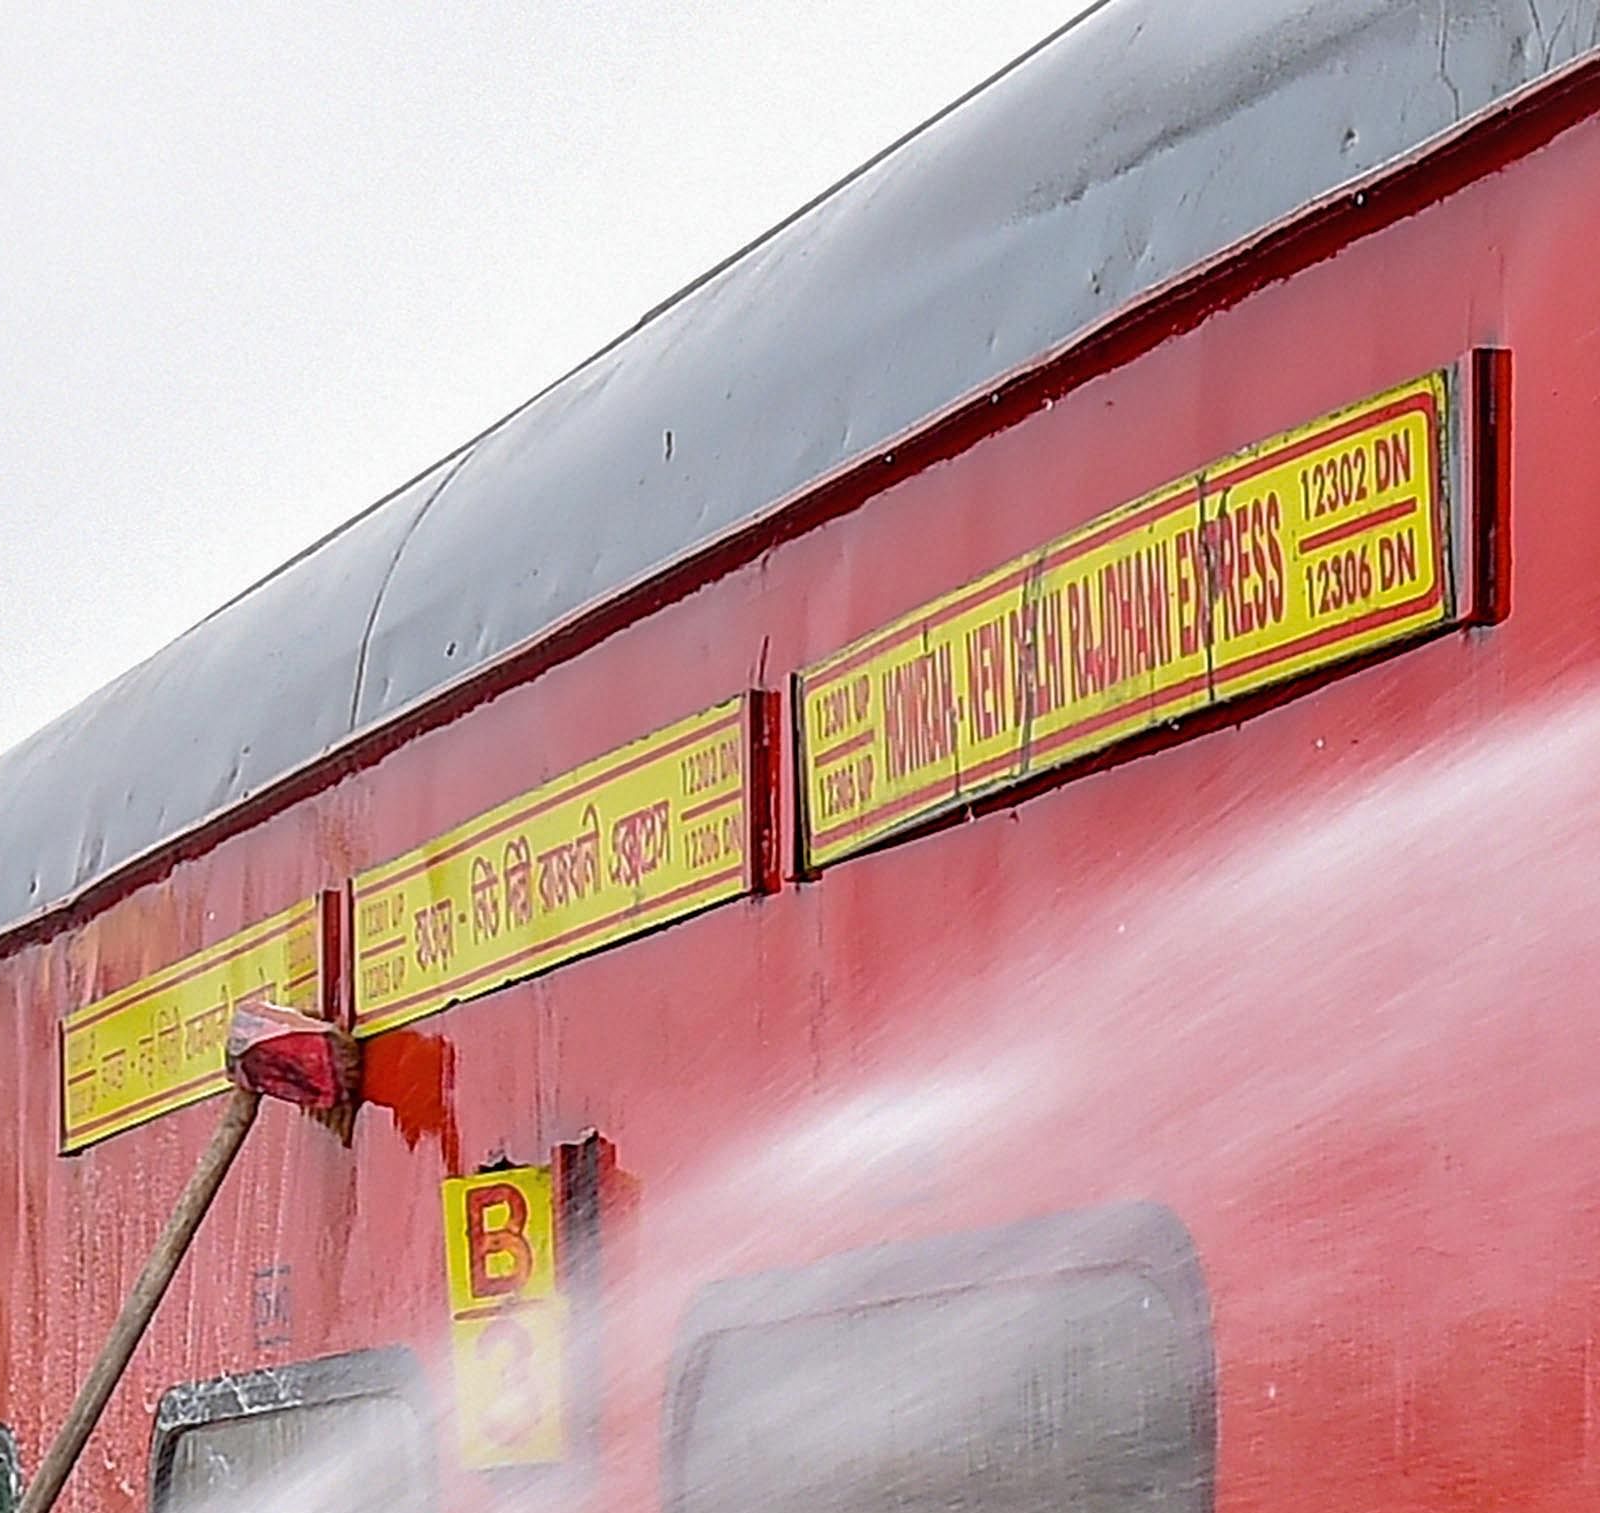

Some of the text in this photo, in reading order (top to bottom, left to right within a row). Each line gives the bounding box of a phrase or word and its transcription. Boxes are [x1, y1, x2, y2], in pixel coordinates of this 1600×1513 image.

[1301, 428, 1410, 520] 12302 DN
[1067, 539, 1171, 702] RAJDHANI
[1176, 491, 1283, 658] EXPRESS
[1306, 527, 1416, 618] 12306 DN
[465, 1182, 534, 1299] B
